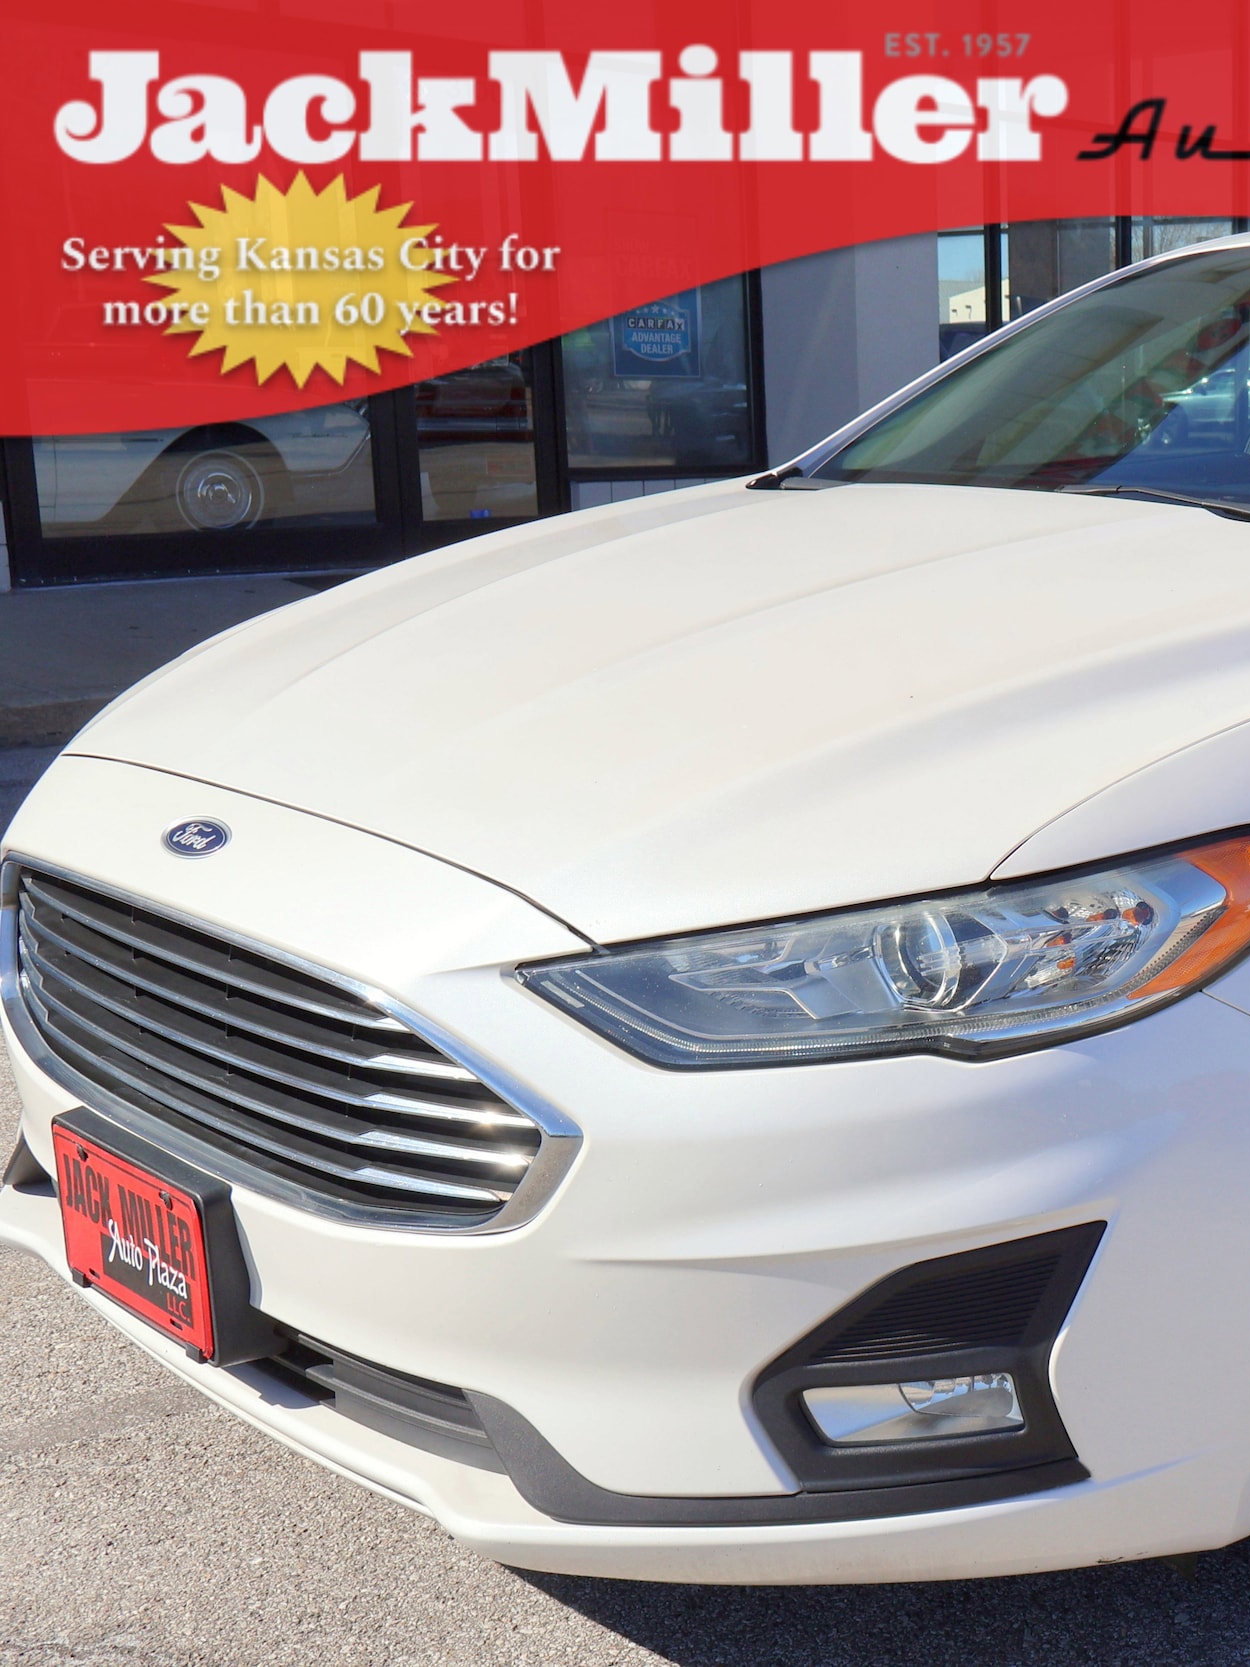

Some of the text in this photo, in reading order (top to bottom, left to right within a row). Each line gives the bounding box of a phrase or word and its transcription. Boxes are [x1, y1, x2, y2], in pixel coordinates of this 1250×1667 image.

[627, 317, 685, 331] CARFAX
[631, 331, 682, 344] ADVANTAGE
[640, 343, 673, 354] DEALER
[172, 823, 216, 850] Ford
[63, 1154, 196, 1281] JACK MILLER
[108, 1219, 188, 1299] Auto Plaza
